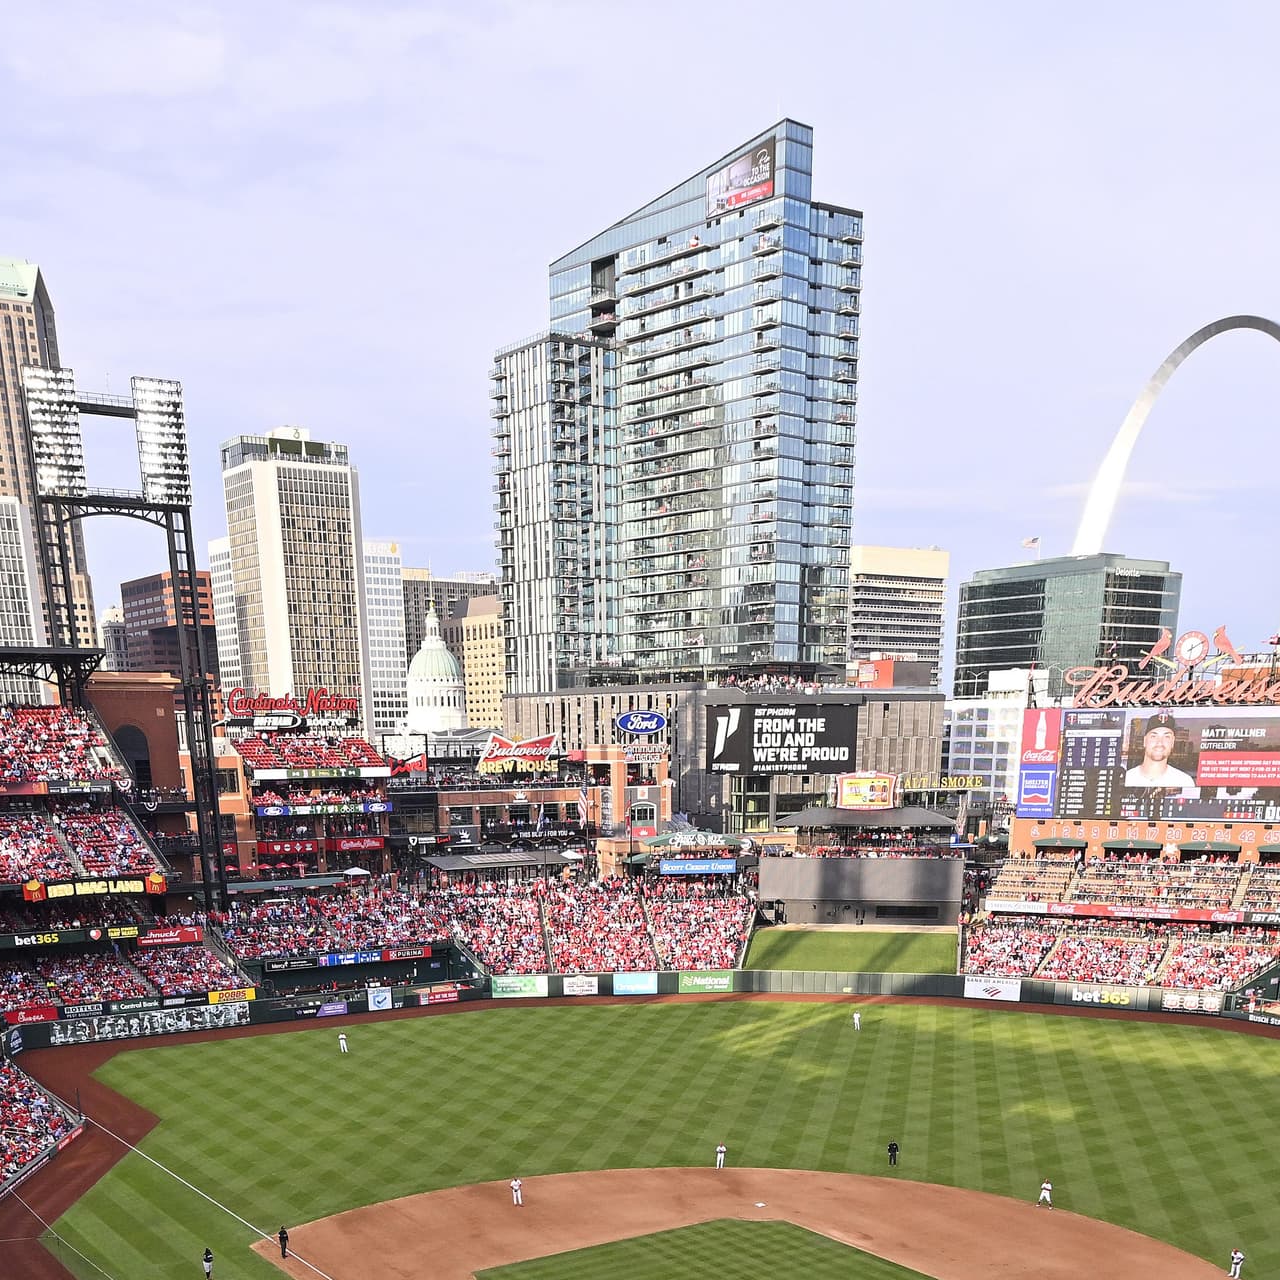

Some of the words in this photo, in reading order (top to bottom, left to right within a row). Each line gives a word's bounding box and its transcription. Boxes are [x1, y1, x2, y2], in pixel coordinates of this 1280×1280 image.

[759, 163, 770, 173] THE
[743, 172, 770, 186] OCCASION
[229, 688, 300, 716] Cardinals
[299, 688, 358, 715] Nation
[627, 713, 658, 730] Ford
[754, 718, 797, 733] FROM
[798, 718, 826, 732] THE
[1201, 729, 1226, 738] MATT
[1227, 728, 1266, 738] WALLNER
[754, 733, 781, 747] LOU
[784, 733, 815, 747] AND
[753, 747, 799, 762] WE'RE
[801, 746, 849, 761] PROUD
[1023, 750, 1057, 762] Coca-Cola
[480, 760, 515, 773] BREW
[517, 760, 559, 772] HOUSE
[941, 776, 983, 788] SMOKE
[1239, 830, 1256, 843] 42
[1263, 830, 1280, 843] 45
[108, 880, 144, 894] LAND
[15, 933, 59, 946] bet365
[397, 950, 422, 958] PURINA
[693, 976, 730, 985] National
[218, 991, 246, 1000] DOBBS
[1072, 989, 1130, 1006] bet365
[120, 1002, 144, 1011] Central
[145, 1000, 160, 1009] Bank
[1249, 1014, 1269, 1024] BUSCH
